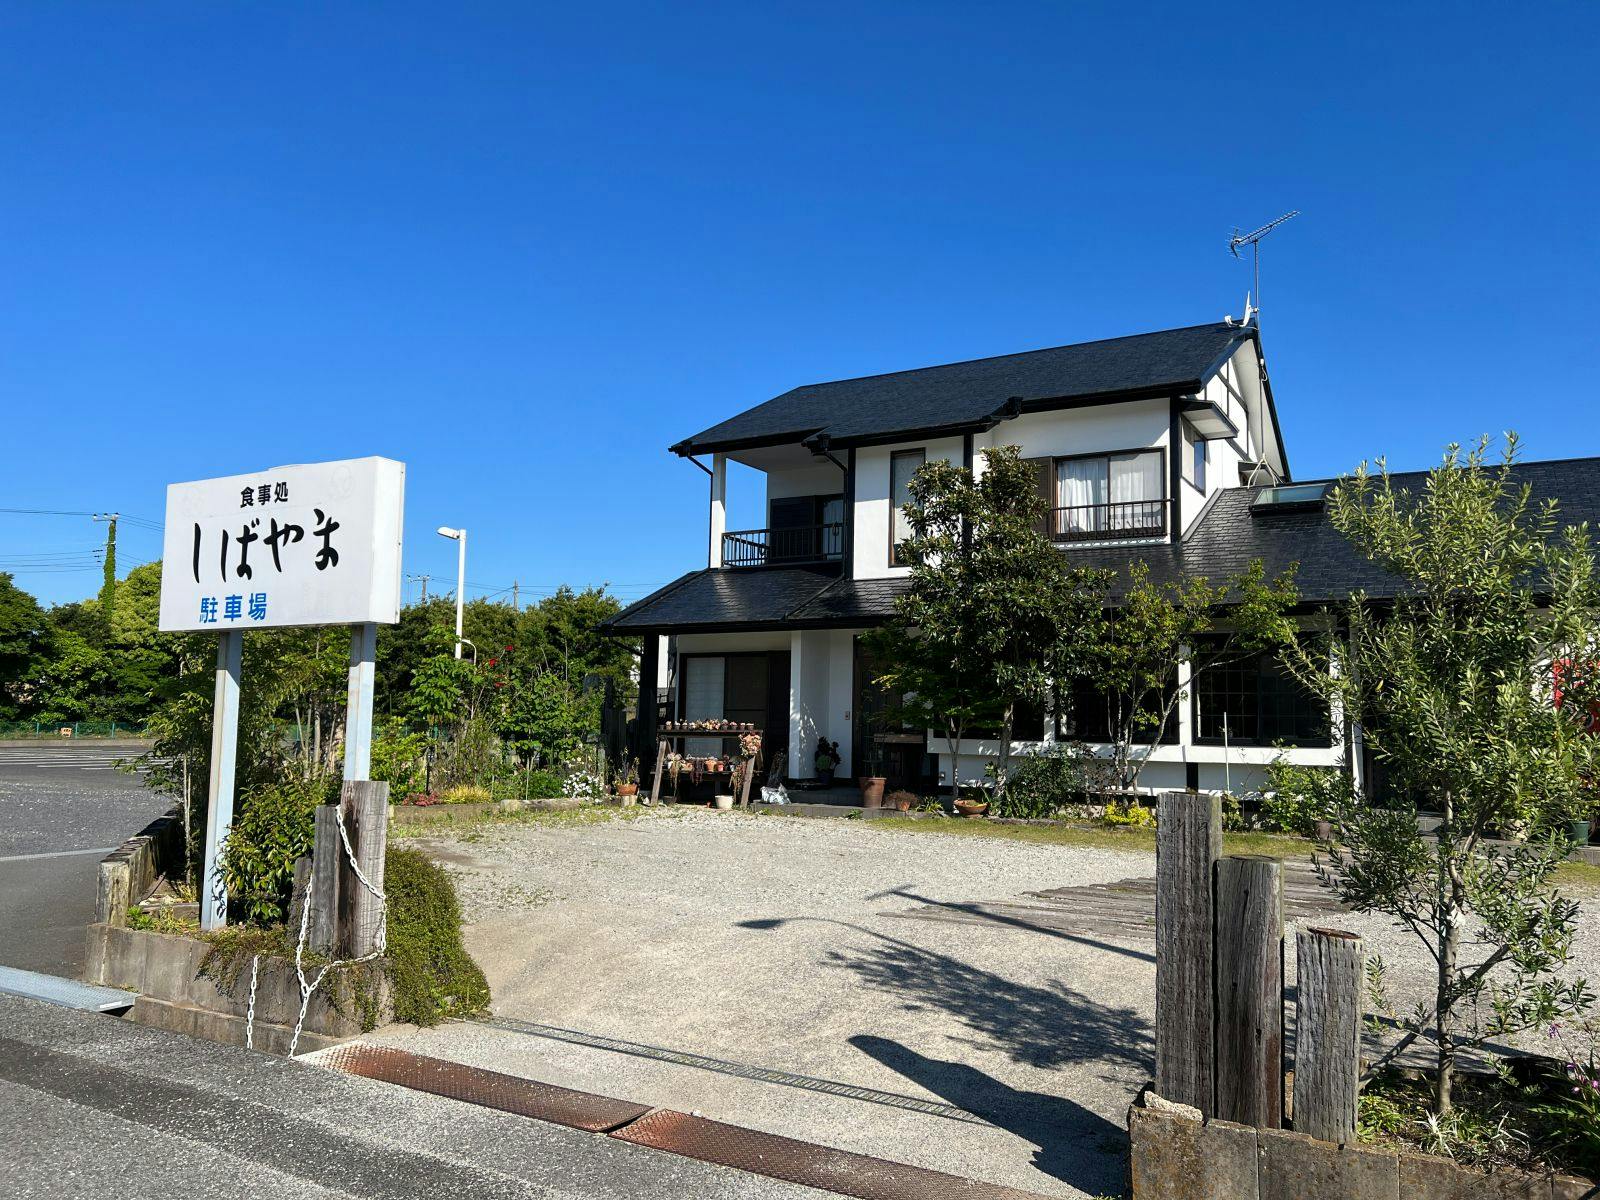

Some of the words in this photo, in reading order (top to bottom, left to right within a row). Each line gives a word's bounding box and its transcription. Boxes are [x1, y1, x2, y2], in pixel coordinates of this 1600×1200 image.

[240, 481, 289, 508] 食事処
[193, 508, 340, 584] しばやま
[199, 592, 267, 624] 駐車場
